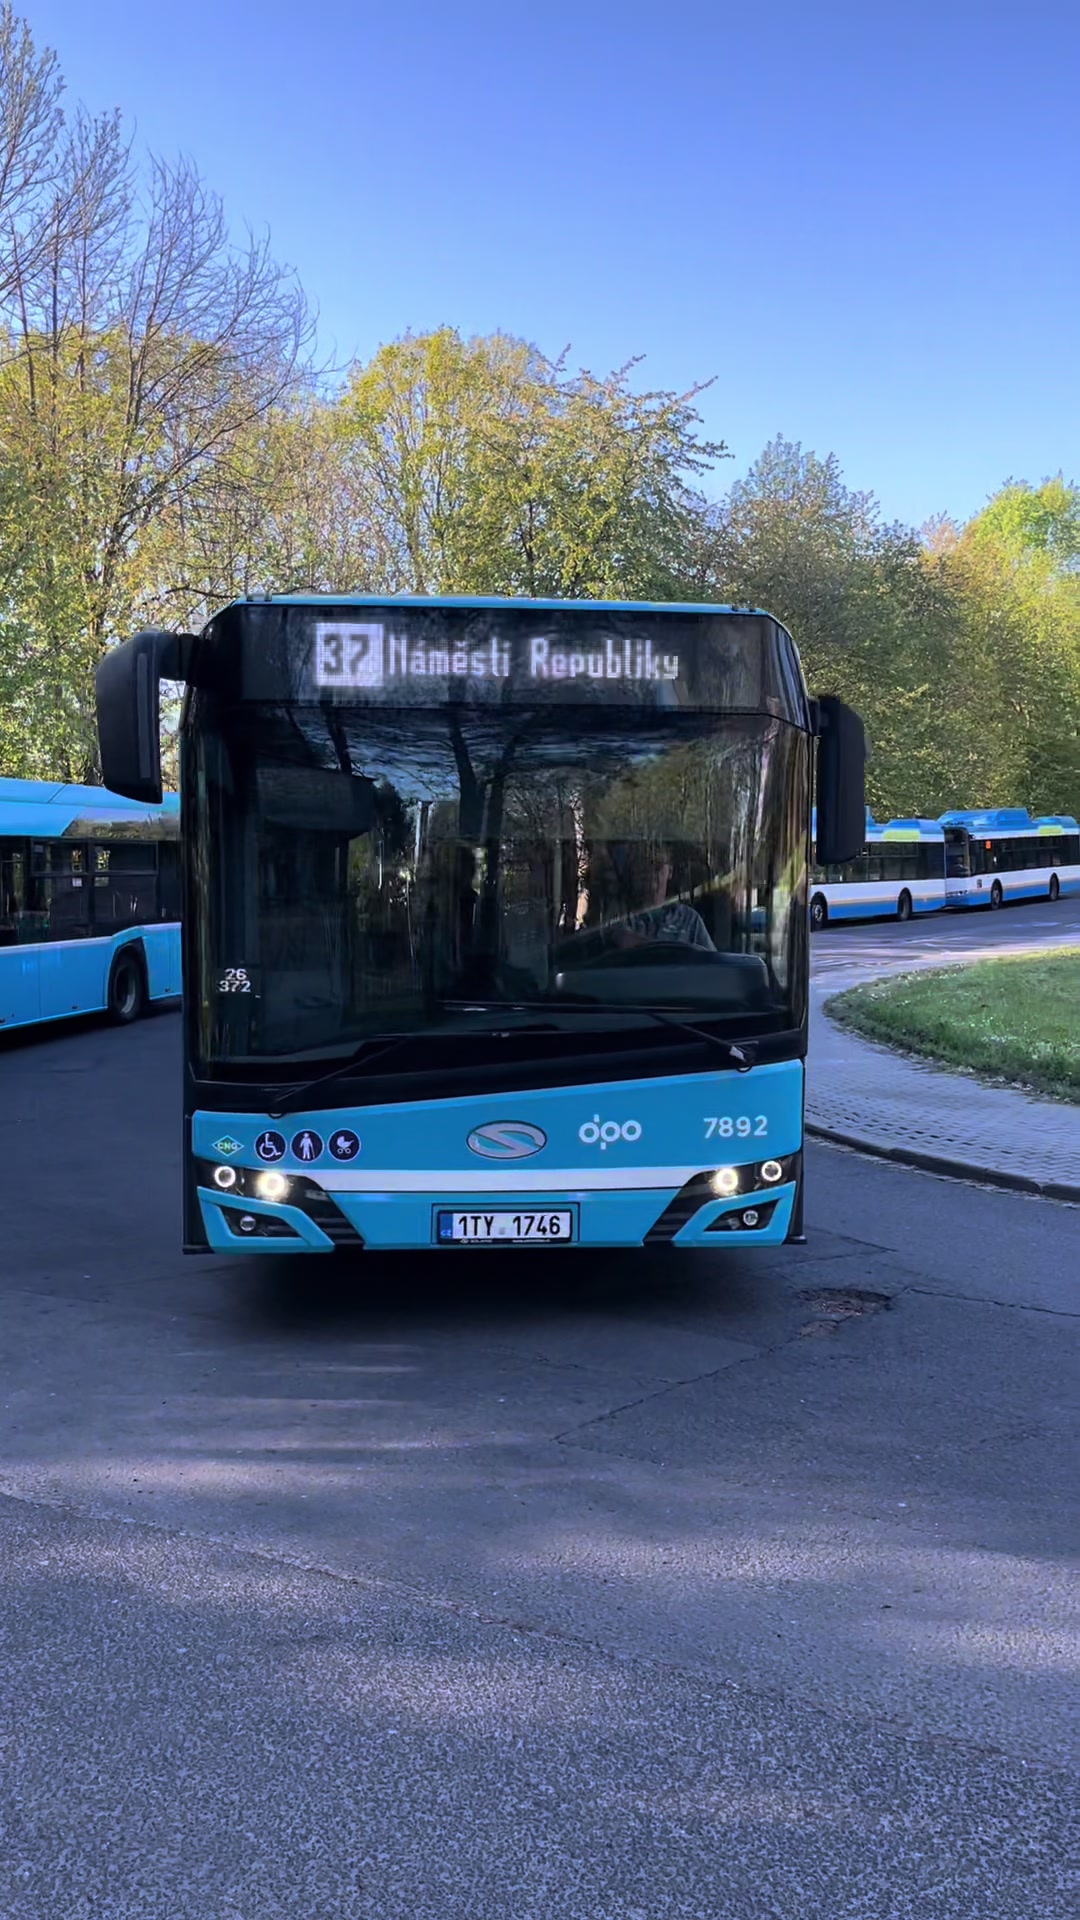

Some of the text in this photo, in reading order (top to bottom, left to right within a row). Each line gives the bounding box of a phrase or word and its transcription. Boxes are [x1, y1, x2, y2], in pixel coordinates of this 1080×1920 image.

[321, 631, 372, 678] 37
[531, 637, 678, 680] Republiky
[224, 968, 247, 980] 26
[219, 980, 251, 993] 372
[578, 1113, 642, 1150] dpo
[703, 1115, 768, 1139] 7892
[217, 1142, 238, 1150] CNG
[458, 1215, 560, 1236] 1TY 1746
